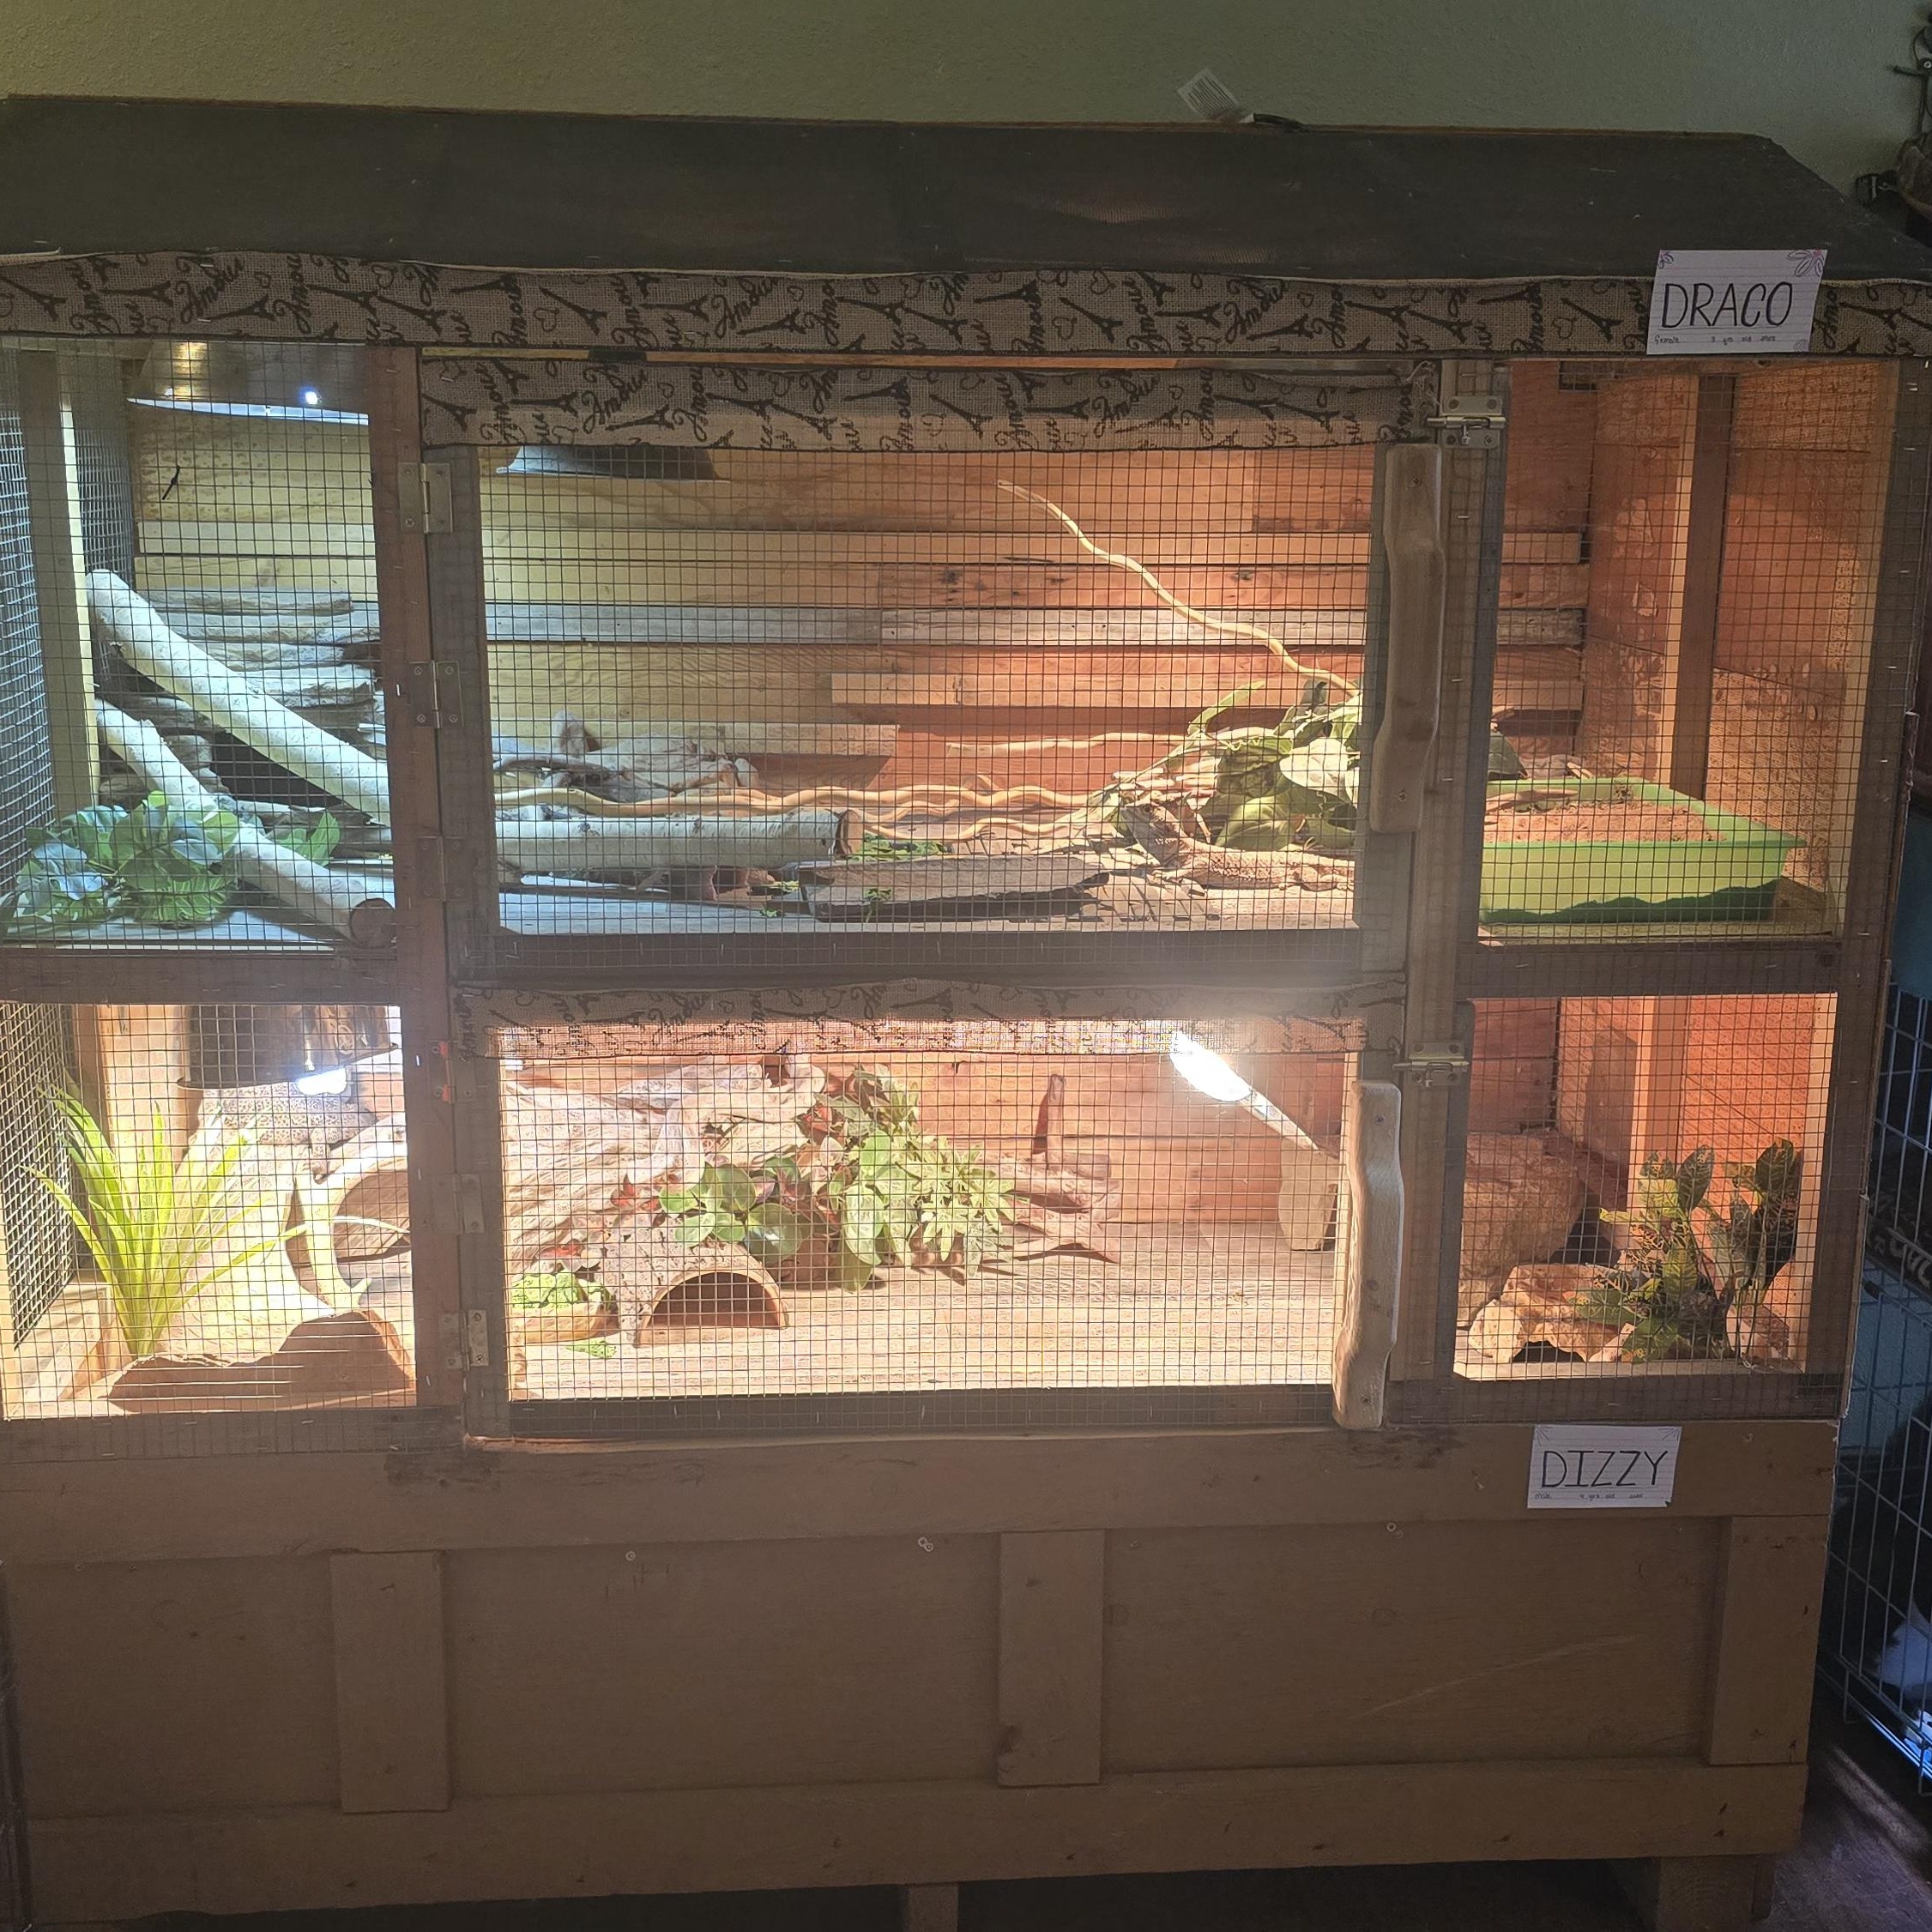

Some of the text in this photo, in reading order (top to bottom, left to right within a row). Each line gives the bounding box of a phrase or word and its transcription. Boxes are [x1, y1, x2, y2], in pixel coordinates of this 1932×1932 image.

[273, 254, 312, 335] Amou
[1661, 281, 1793, 329] DRACO
[672, 367, 709, 443] Amou
[1541, 1450, 1669, 1488] DIZZY
